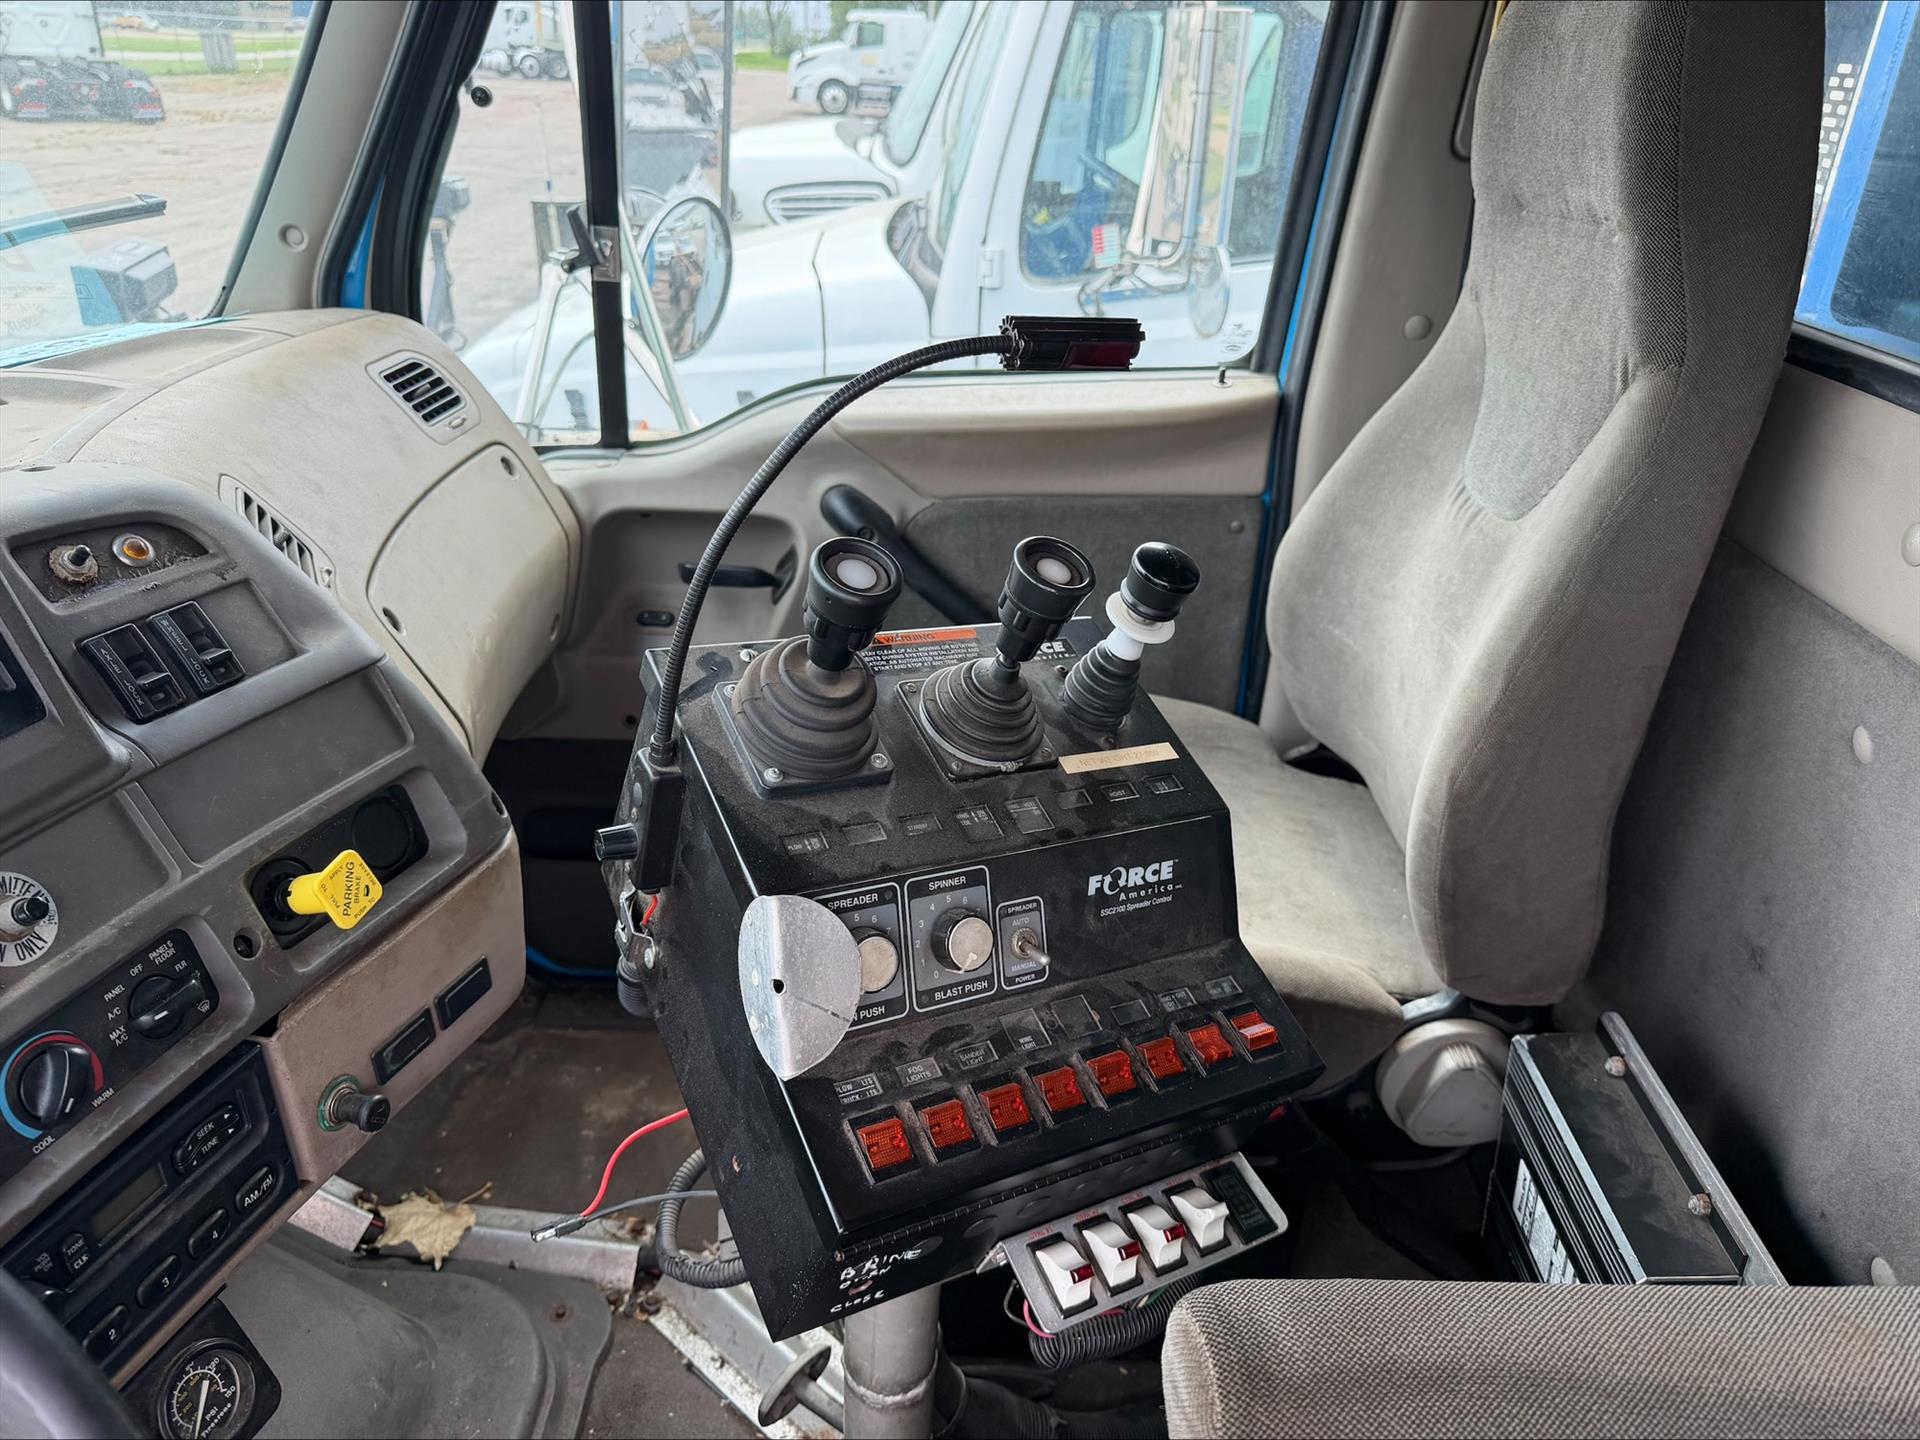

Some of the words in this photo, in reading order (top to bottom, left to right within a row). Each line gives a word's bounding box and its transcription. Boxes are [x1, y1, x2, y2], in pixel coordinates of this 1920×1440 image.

[883, 632, 936, 644] WARNING
[100, 648, 123, 675] AXLE
[123, 678, 145, 706] LOCK
[928, 876, 967, 891] SPINNER
[1087, 859, 1174, 897] FORCE
[343, 861, 355, 917] PARKING
[353, 876, 362, 904] BRAKE
[1119, 883, 1174, 901] America
[827, 893, 879, 911] SPREADER
[945, 895, 952, 904] 5
[962, 896, 968, 905] 6
[1126, 900, 1152, 913] Spreader
[1151, 895, 1173, 907] Control
[929, 903, 936, 912] 4
[1006, 901, 1038, 914] SPREADER
[854, 913, 860, 922] 5
[871, 915, 878, 924] 6
[918, 919, 925, 928] 3
[1011, 916, 1030, 927] AUTO
[15, 931, 48, 961] ONLY
[914, 939, 921, 949] 2
[154, 947, 176, 966] FLOOR
[920, 958, 926, 967] 1
[129, 963, 144, 977] OFF
[174, 960, 188, 972] FLR
[1010, 961, 1037, 972] MANUAL
[933, 969, 940, 979] 0
[1014, 973, 1036, 984] POWER
[103, 984, 126, 1002] PANEL
[934, 985, 963, 1001] BLAST
[964, 980, 988, 995] PUSH
[107, 1006, 122, 1021] A/C
[860, 1005, 885, 1020] PUSH
[109, 1025, 127, 1041] MAX
[966, 1056, 984, 1066] LIGHT
[906, 1070, 933, 1084] LIGHTS
[907, 1064, 924, 1075] FOG
[91, 1087, 116, 1108] WARM
[196, 1121, 215, 1140] SEEK
[32, 1135, 57, 1155] COOL
[201, 1136, 220, 1154] TUNE
[244, 1174, 275, 1208] AM/FM
[212, 1229, 219, 1240] 4
[73, 1253, 90, 1270] CLK
[840, 1248, 923, 1282] BRINE
[162, 1277, 170, 1288] 3
[830, 1289, 885, 1313] CLOSE
[108, 1328, 117, 1341] 2
[224, 1385, 236, 1399] 150
[205, 1405, 219, 1421] PSI
